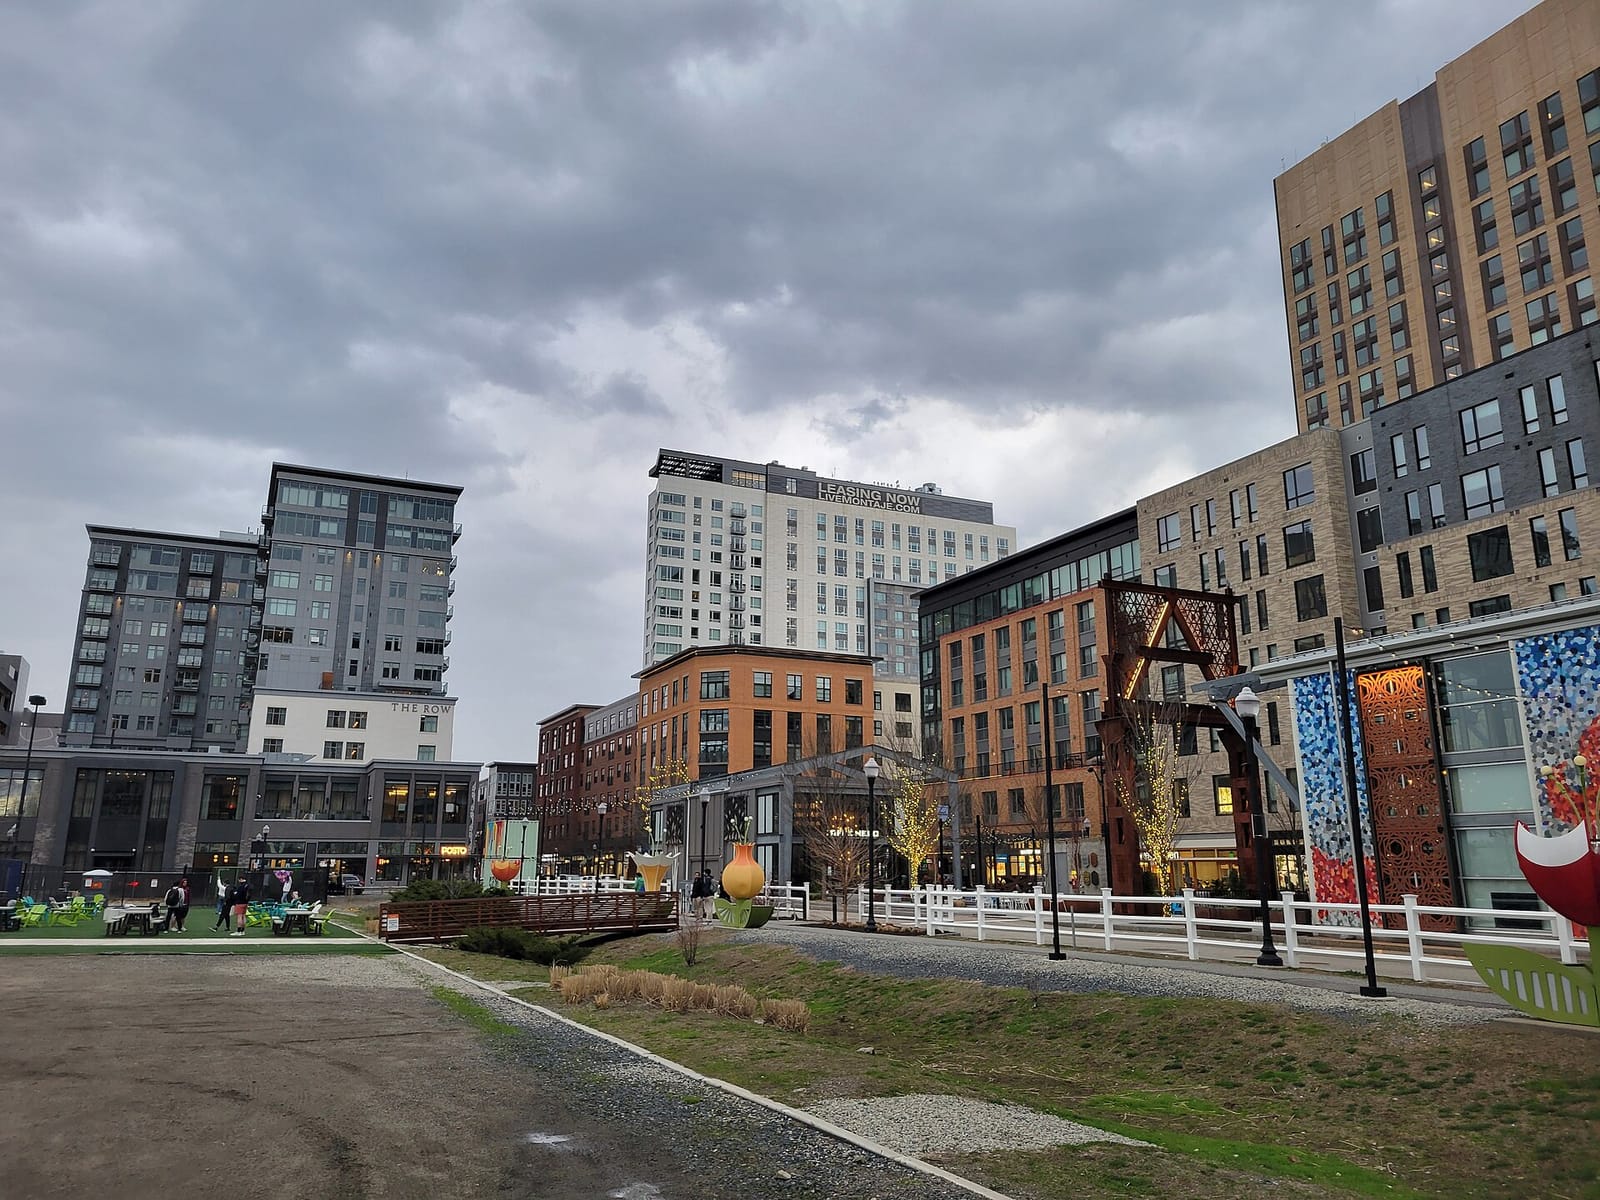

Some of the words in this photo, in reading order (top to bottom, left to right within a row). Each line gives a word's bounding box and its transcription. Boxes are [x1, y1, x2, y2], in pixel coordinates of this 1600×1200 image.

[818, 482, 881, 501] LEASING
[886, 492, 920, 506] NOW
[818, 492, 920, 514] LIVEMONTAJE.COM
[391, 702, 418, 712] THE
[423, 704, 451, 714] ROW
[441, 846, 467, 855] POSTO
